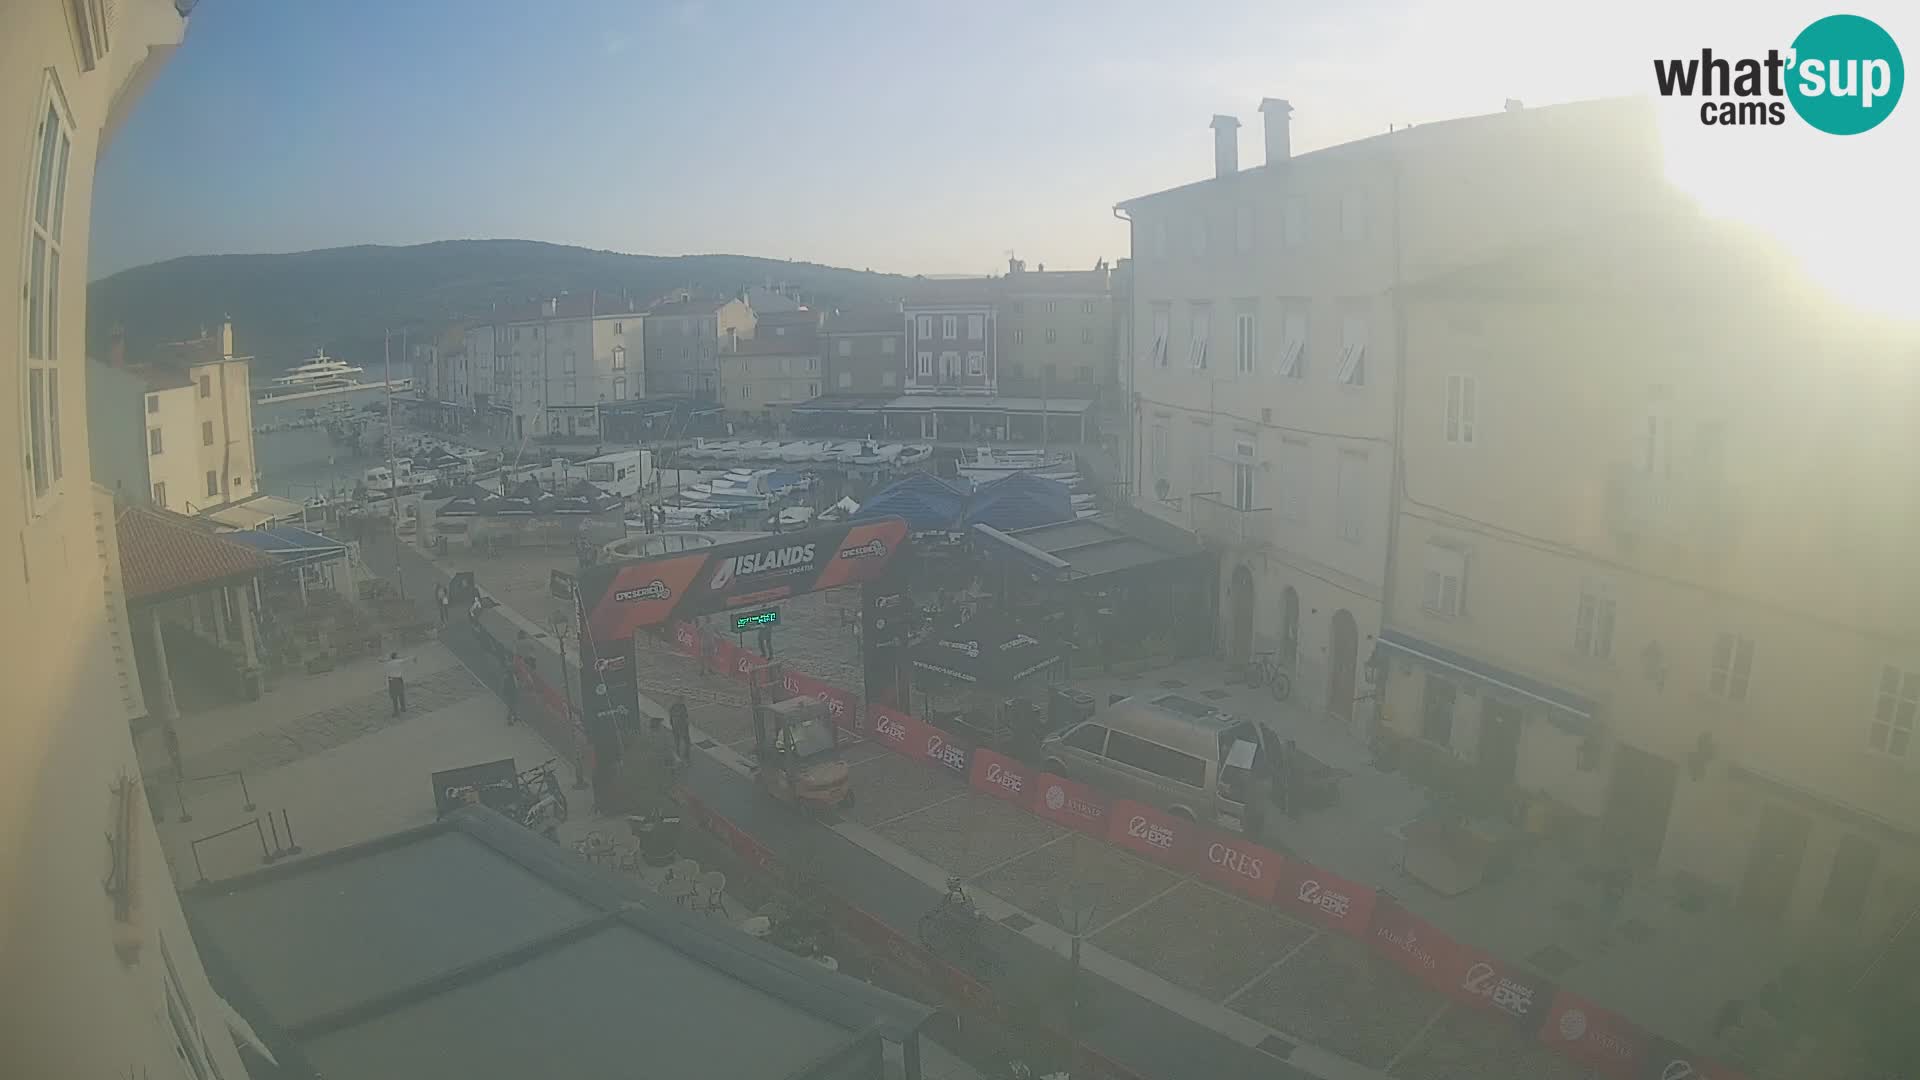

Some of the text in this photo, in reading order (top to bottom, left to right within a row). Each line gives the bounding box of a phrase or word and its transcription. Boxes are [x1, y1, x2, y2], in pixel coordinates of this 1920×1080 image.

[943, 753, 965, 769] EPIC
[1001, 777, 1024, 793] EPIC
[1147, 829, 1175, 849] EPIC
[1208, 843, 1264, 880] CRES
[1320, 896, 1351, 916] EPIC
[1492, 986, 1533, 1015] EPIC
